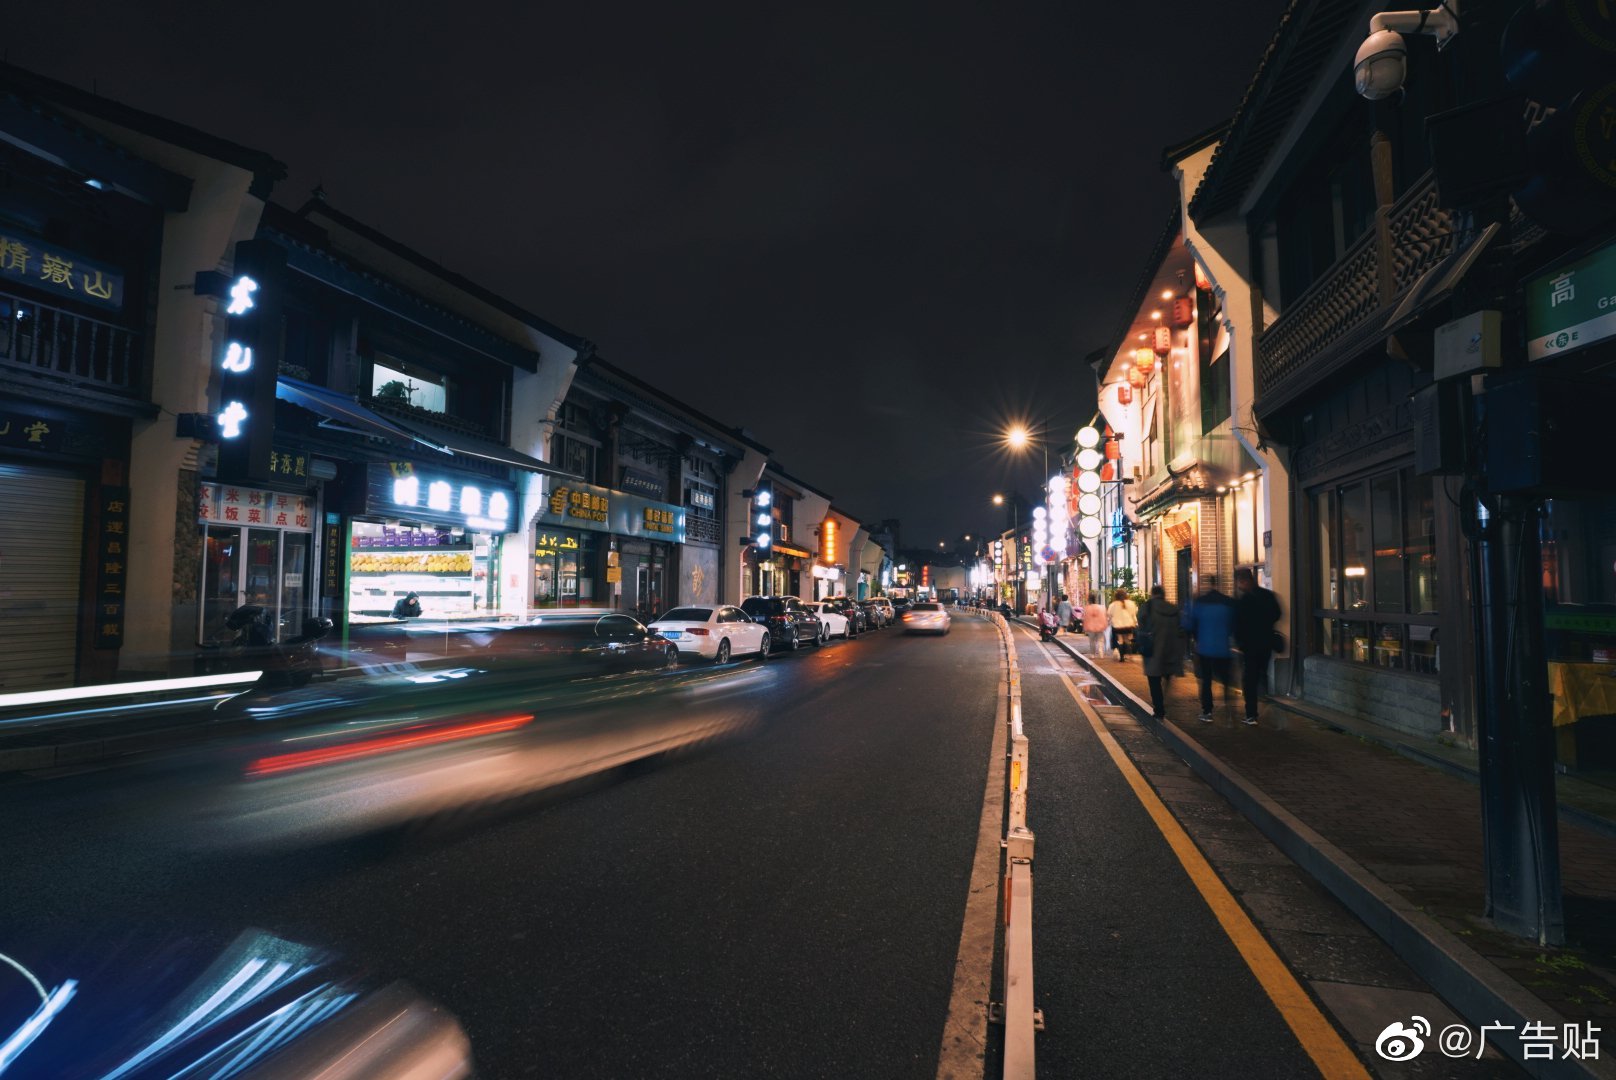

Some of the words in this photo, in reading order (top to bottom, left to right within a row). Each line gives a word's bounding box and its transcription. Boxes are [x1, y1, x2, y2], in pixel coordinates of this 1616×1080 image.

[1549, 271, 1575, 307] 高
[1571, 332, 1579, 341] E
[571, 490, 609, 512] 中国邮政
[570, 507, 591, 520] CHINA
